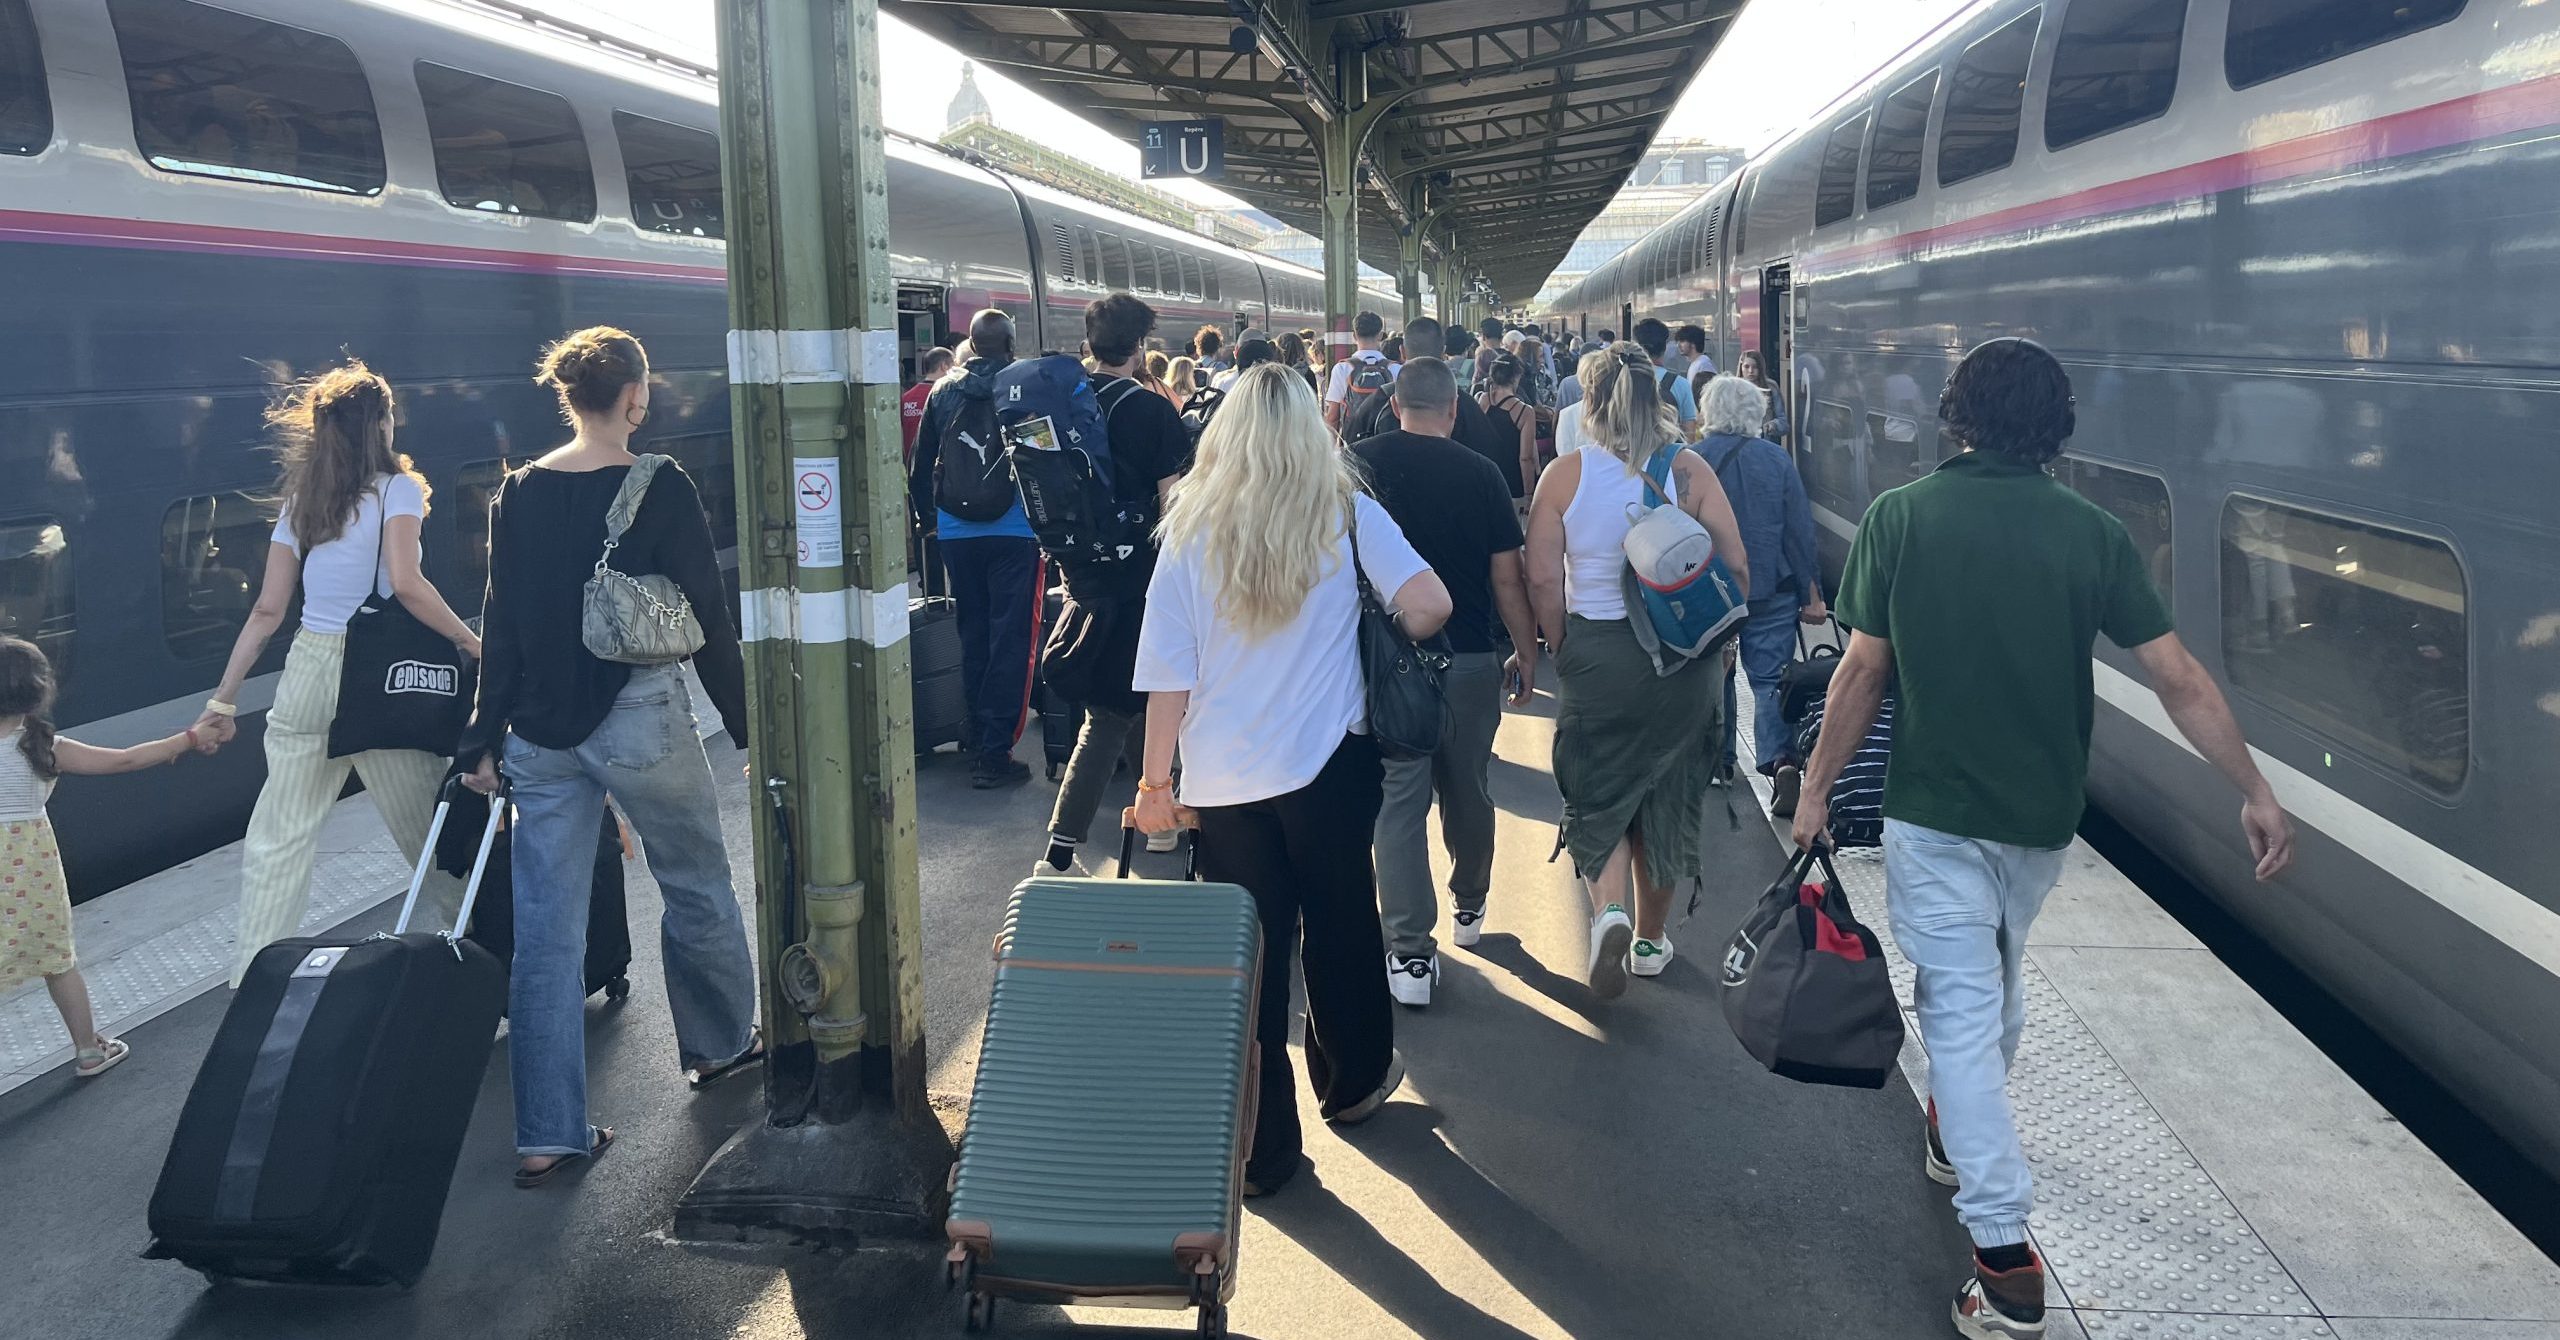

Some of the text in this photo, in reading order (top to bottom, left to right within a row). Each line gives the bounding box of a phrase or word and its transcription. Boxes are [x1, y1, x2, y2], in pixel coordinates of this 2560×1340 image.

[1146, 133, 1162, 147] 11
[1180, 136, 1209, 175] U
[1488, 297, 1494, 305] S
[394, 665, 451, 691] episode
